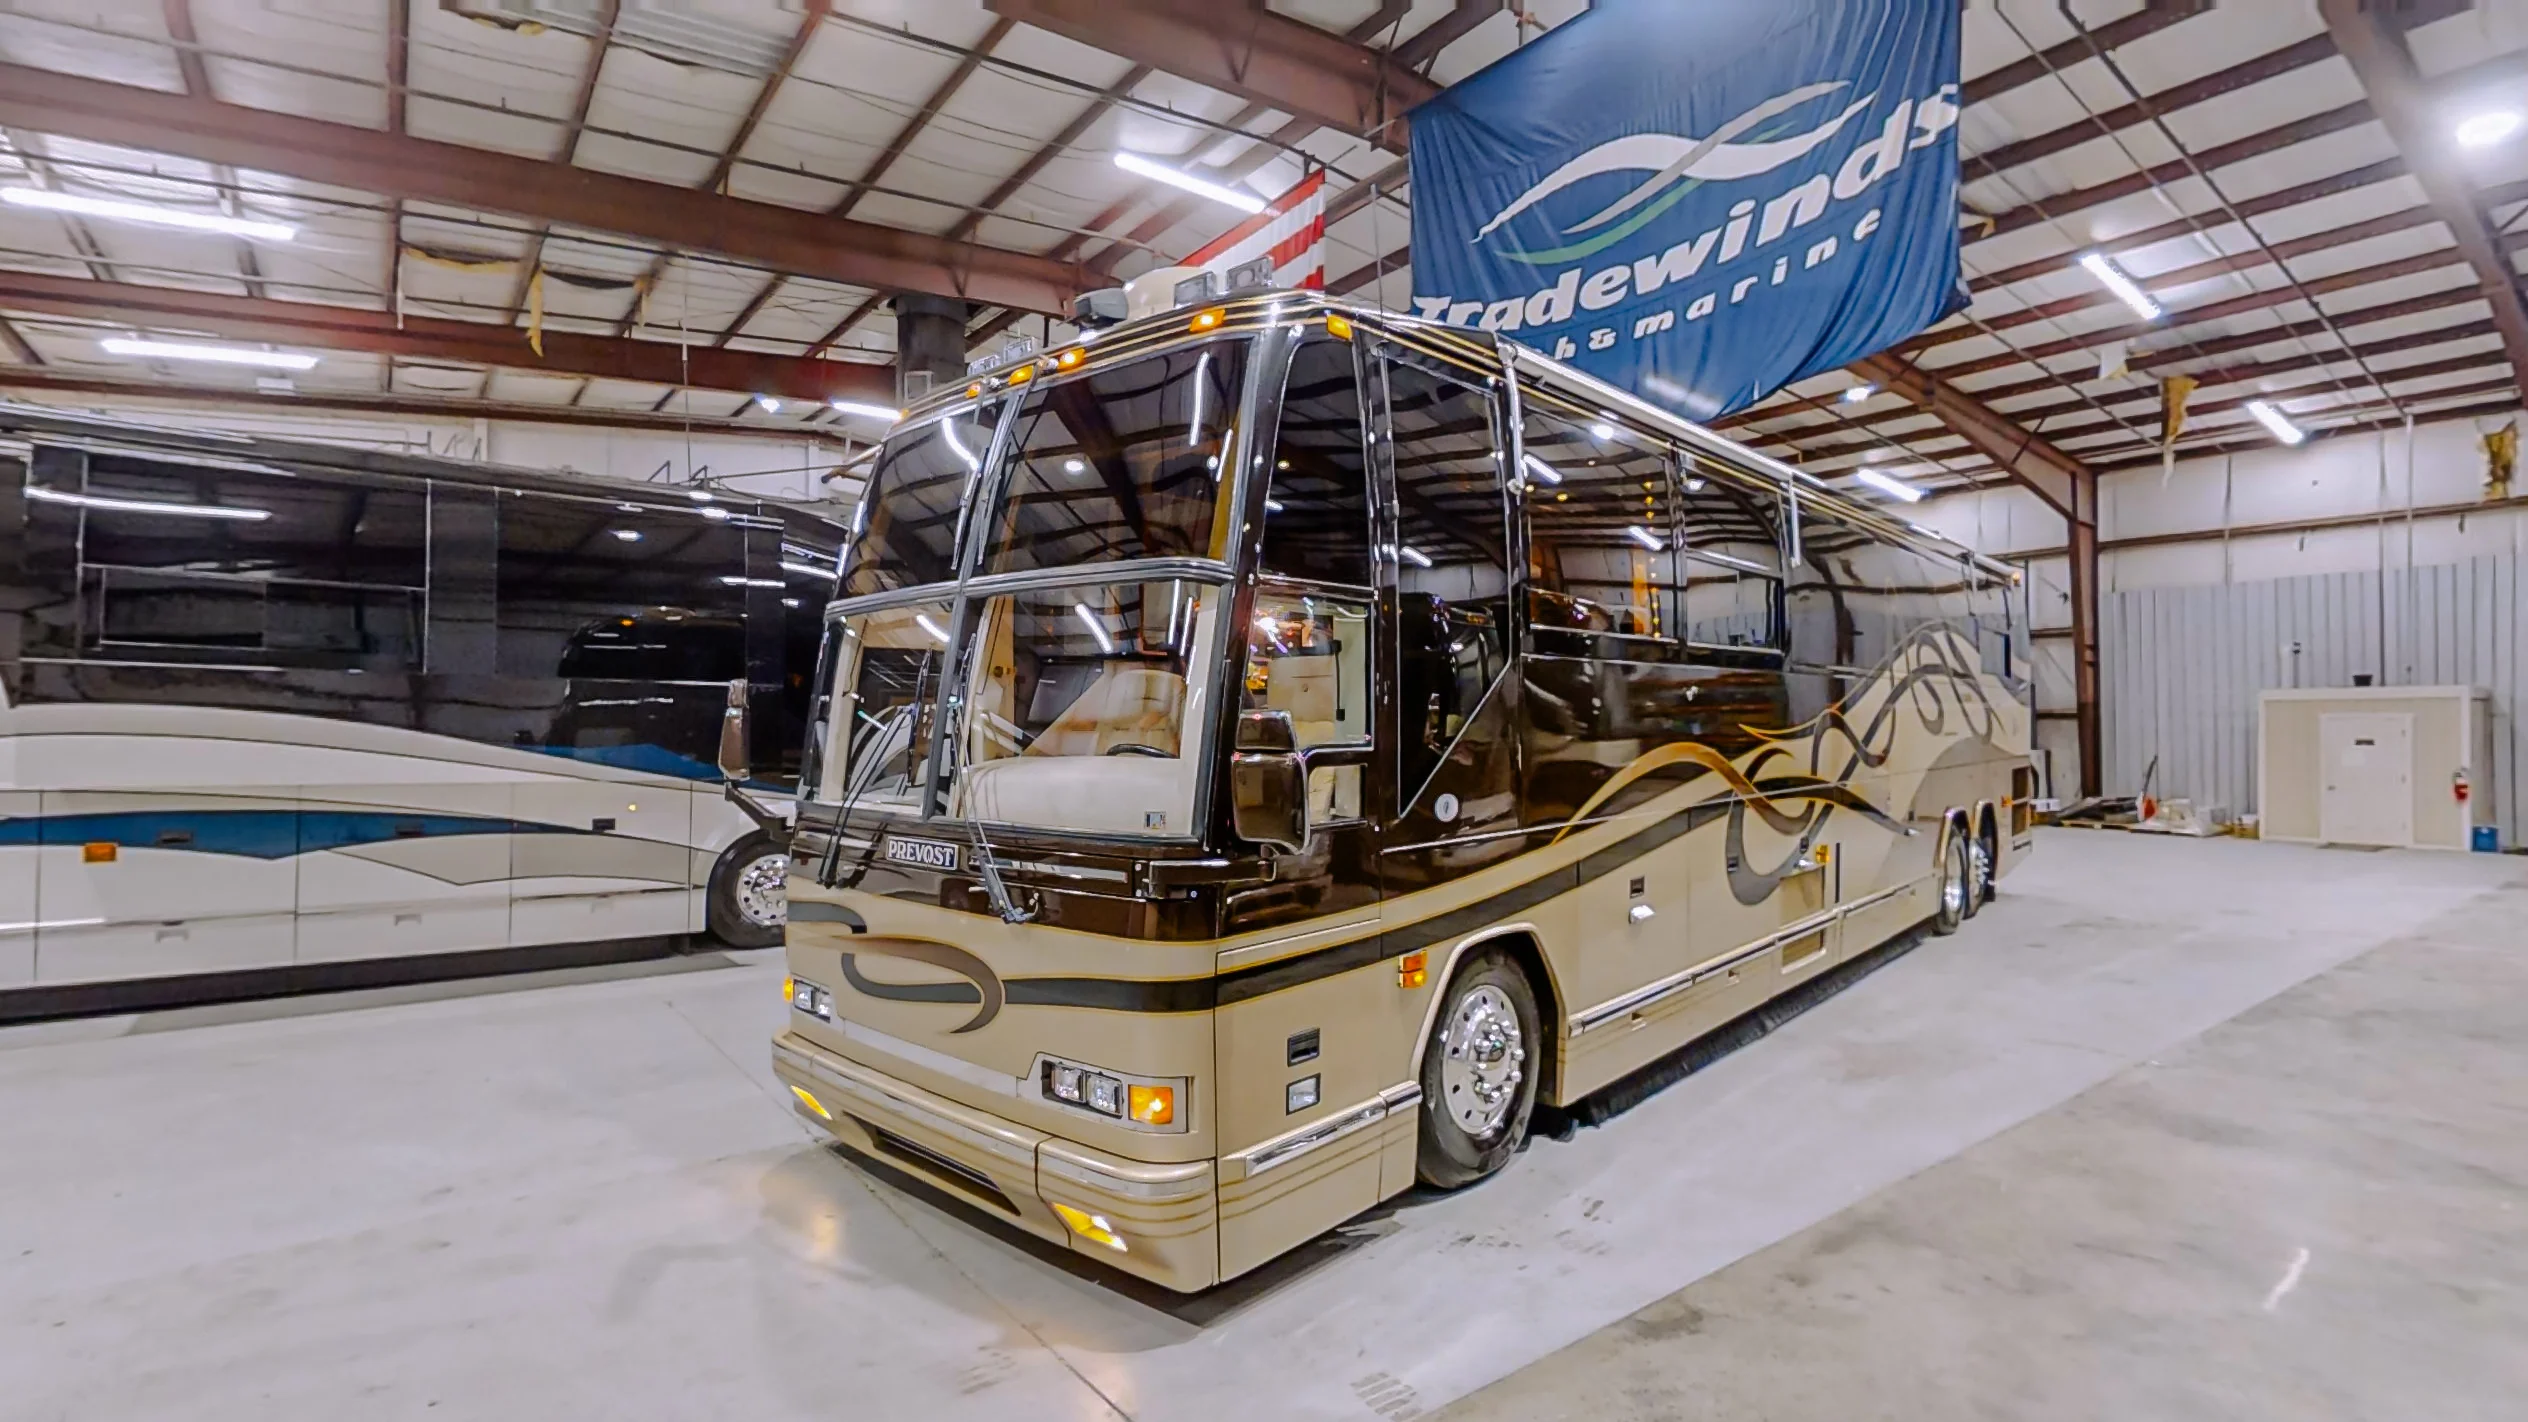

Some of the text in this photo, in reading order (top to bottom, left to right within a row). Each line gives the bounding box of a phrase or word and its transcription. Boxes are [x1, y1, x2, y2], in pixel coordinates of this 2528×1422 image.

[1412, 83, 1960, 332] Tradewinds
[1588, 208, 1881, 350] & marine
[888, 840, 953, 867] PREVOST
